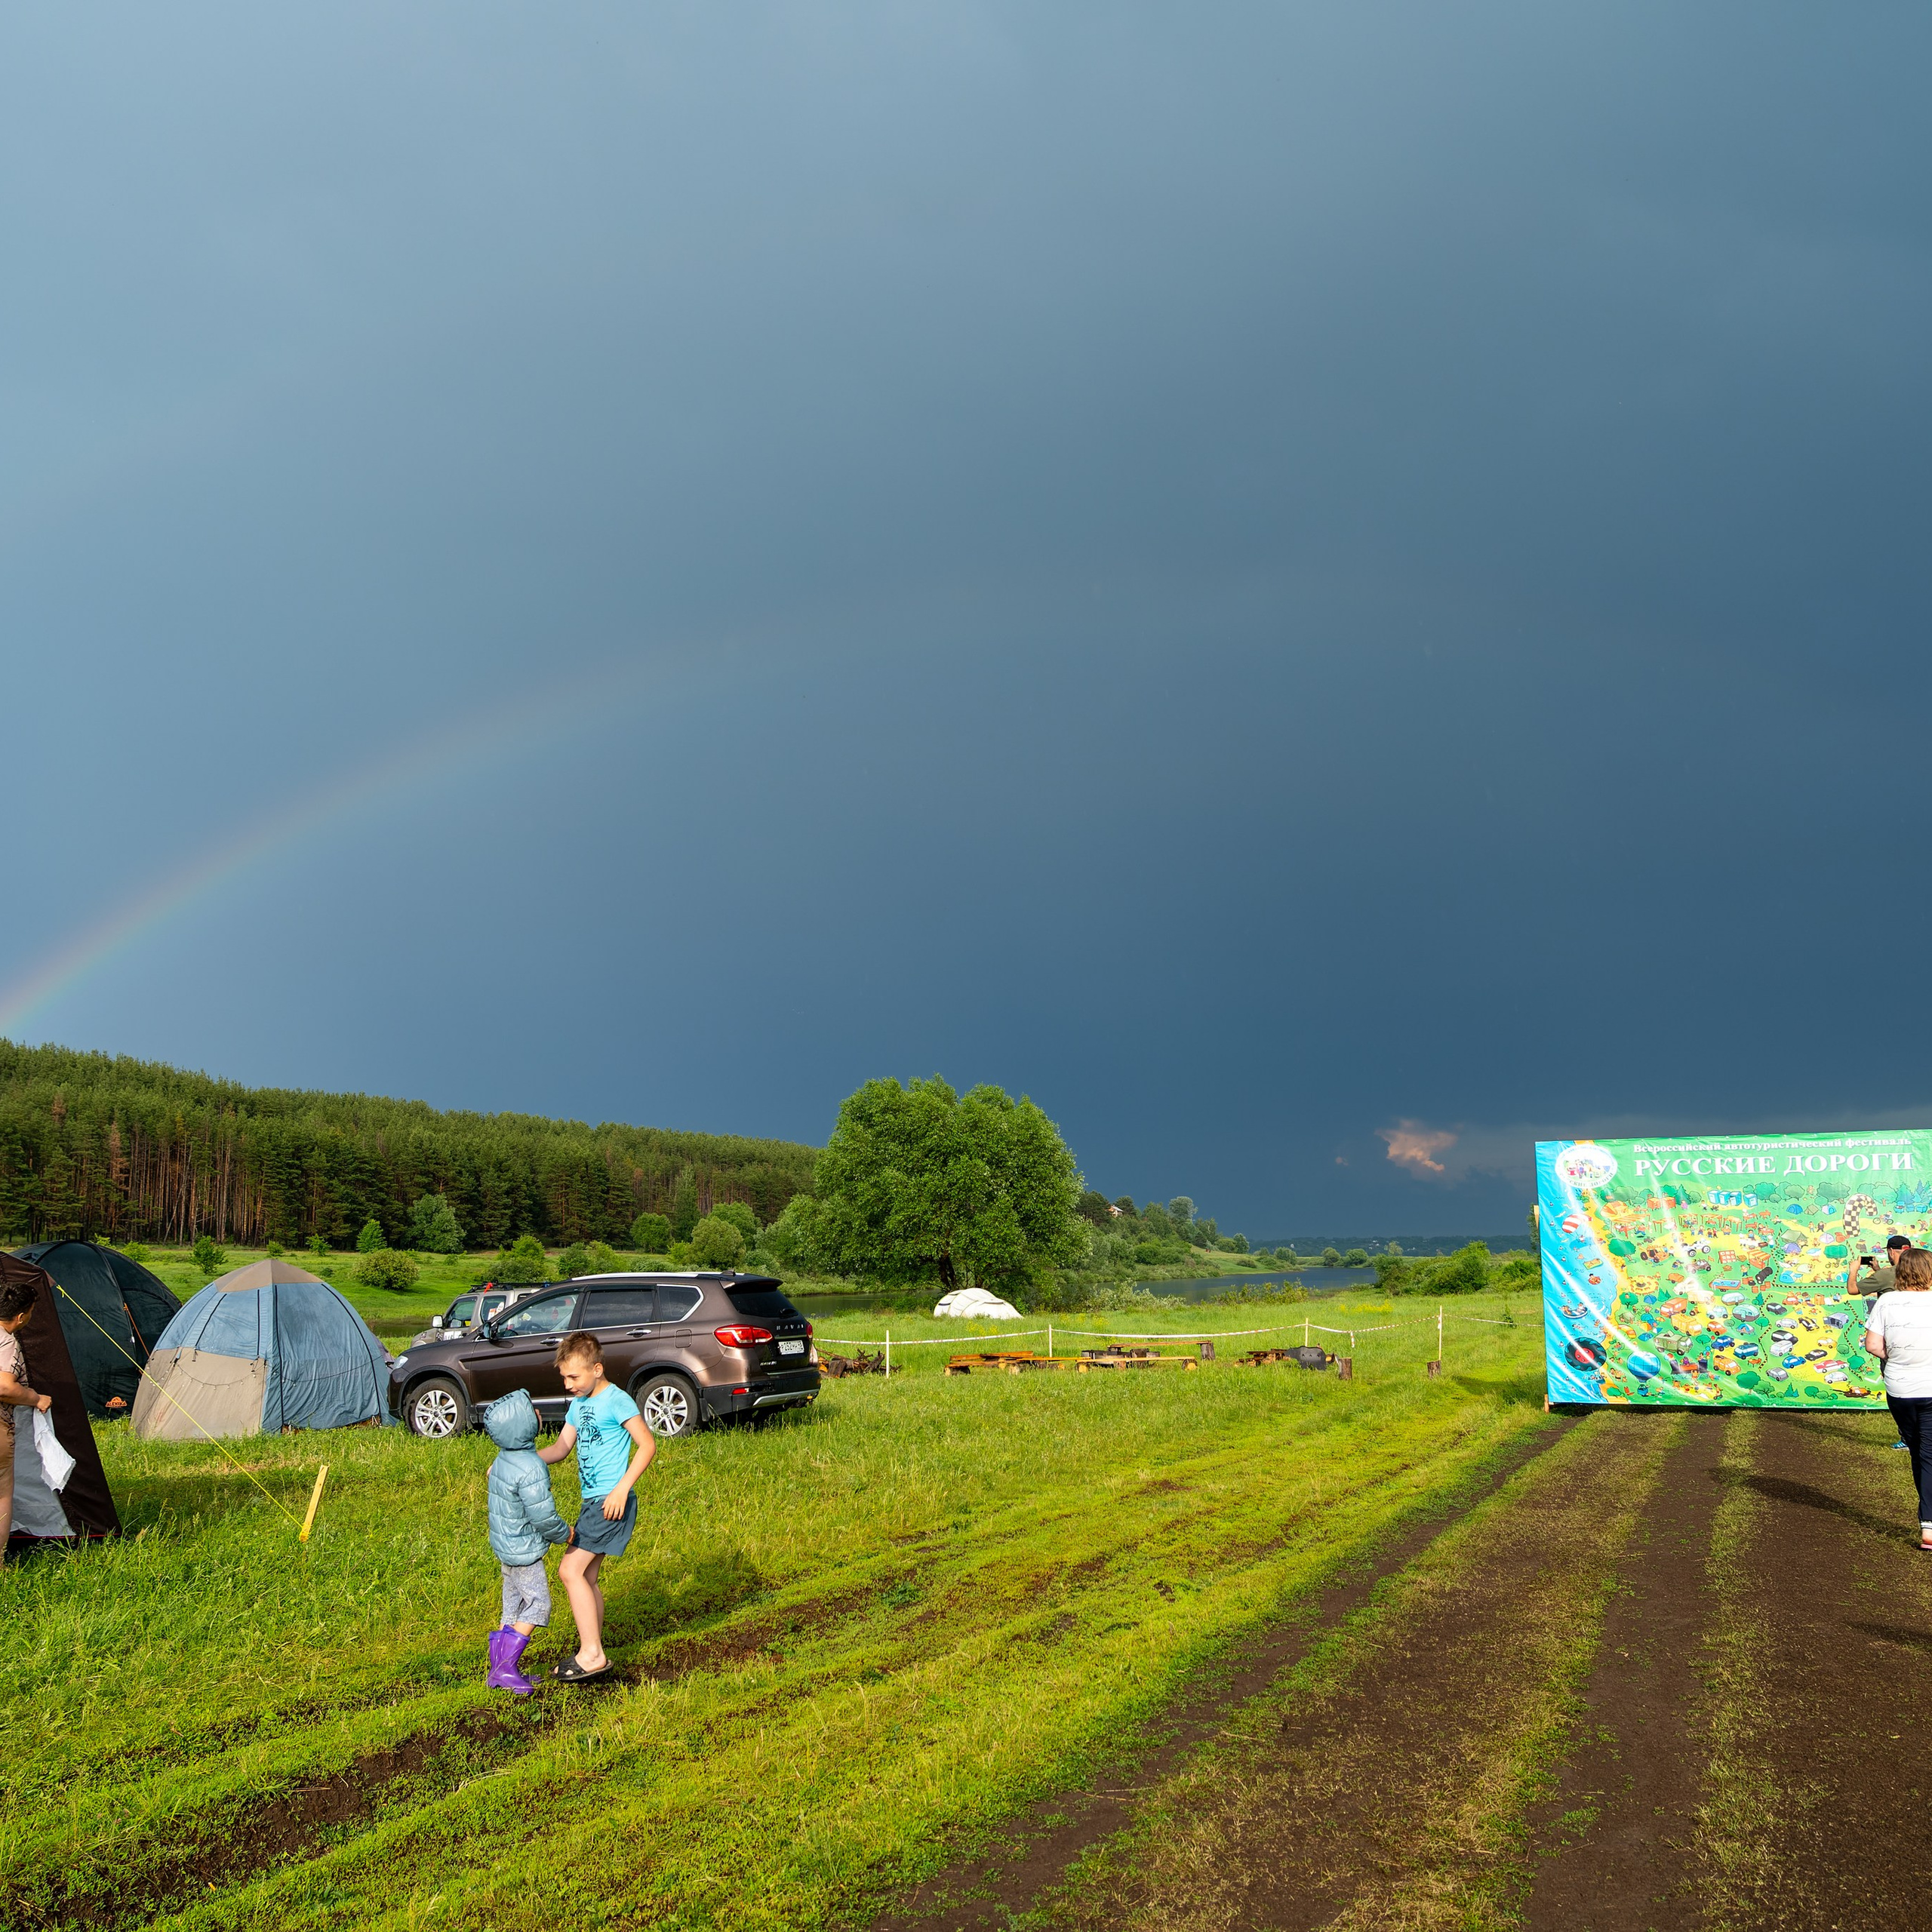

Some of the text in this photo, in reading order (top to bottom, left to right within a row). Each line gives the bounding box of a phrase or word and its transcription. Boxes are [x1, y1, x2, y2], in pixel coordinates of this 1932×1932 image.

[1634, 1138, 1912, 1155] Всероссийский автотуристический фестиваль
[1634, 1152, 1914, 1177] РУССКИЕ ДОРОГИ
